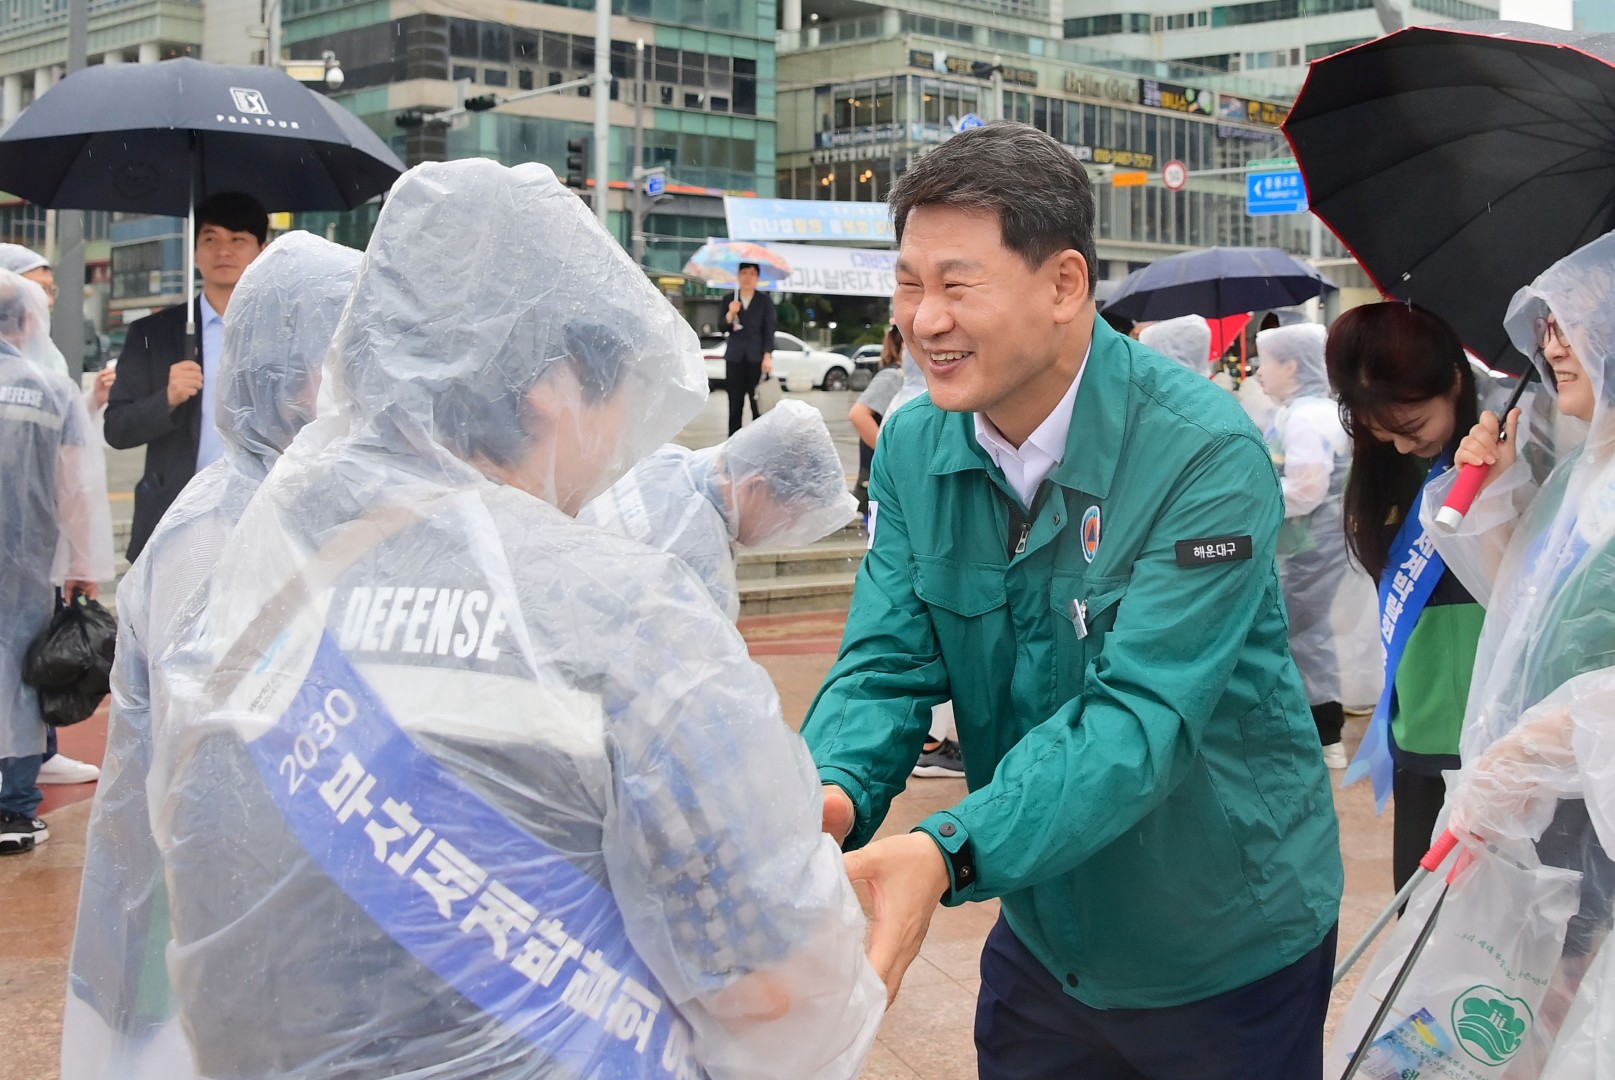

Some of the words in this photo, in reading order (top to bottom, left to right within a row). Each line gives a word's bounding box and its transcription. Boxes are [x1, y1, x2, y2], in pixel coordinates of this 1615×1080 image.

[216, 114, 249, 124] PGA
[254, 117, 300, 129] TOUR
[1193, 542, 1237, 560] 해운대구
[339, 587, 508, 661] DEFENSE
[279, 689, 357, 796] 2030
[317, 751, 662, 1054] 부산세계박람회
